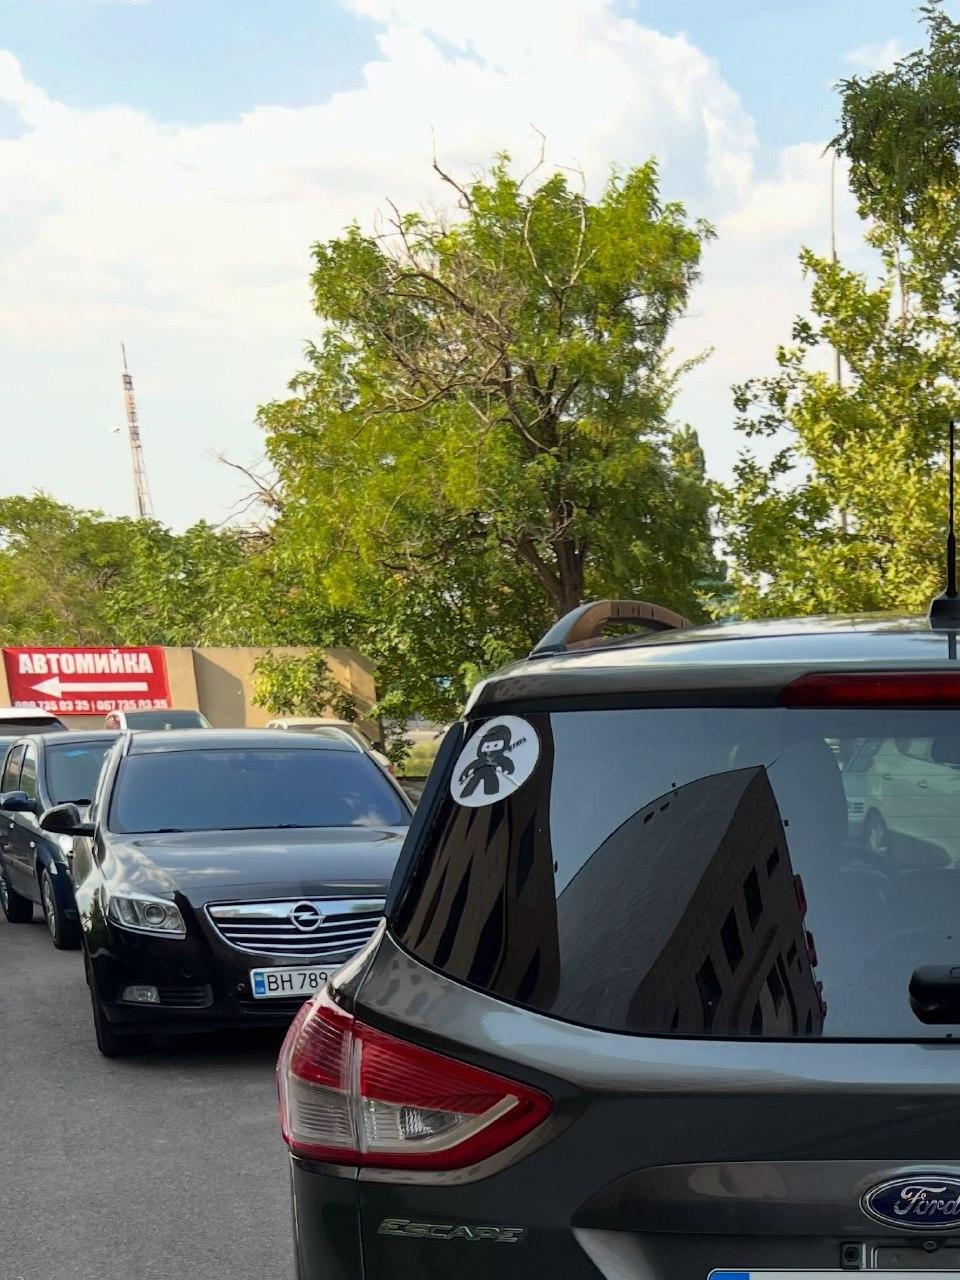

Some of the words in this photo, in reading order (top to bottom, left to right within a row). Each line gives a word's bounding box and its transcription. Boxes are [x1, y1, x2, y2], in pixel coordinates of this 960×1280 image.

[18, 649, 154, 675] АВТОМИЙКА
[267, 973, 293, 991] BH
[298, 971, 328, 989] 789
[377, 1218, 525, 1243] ESCAPE
